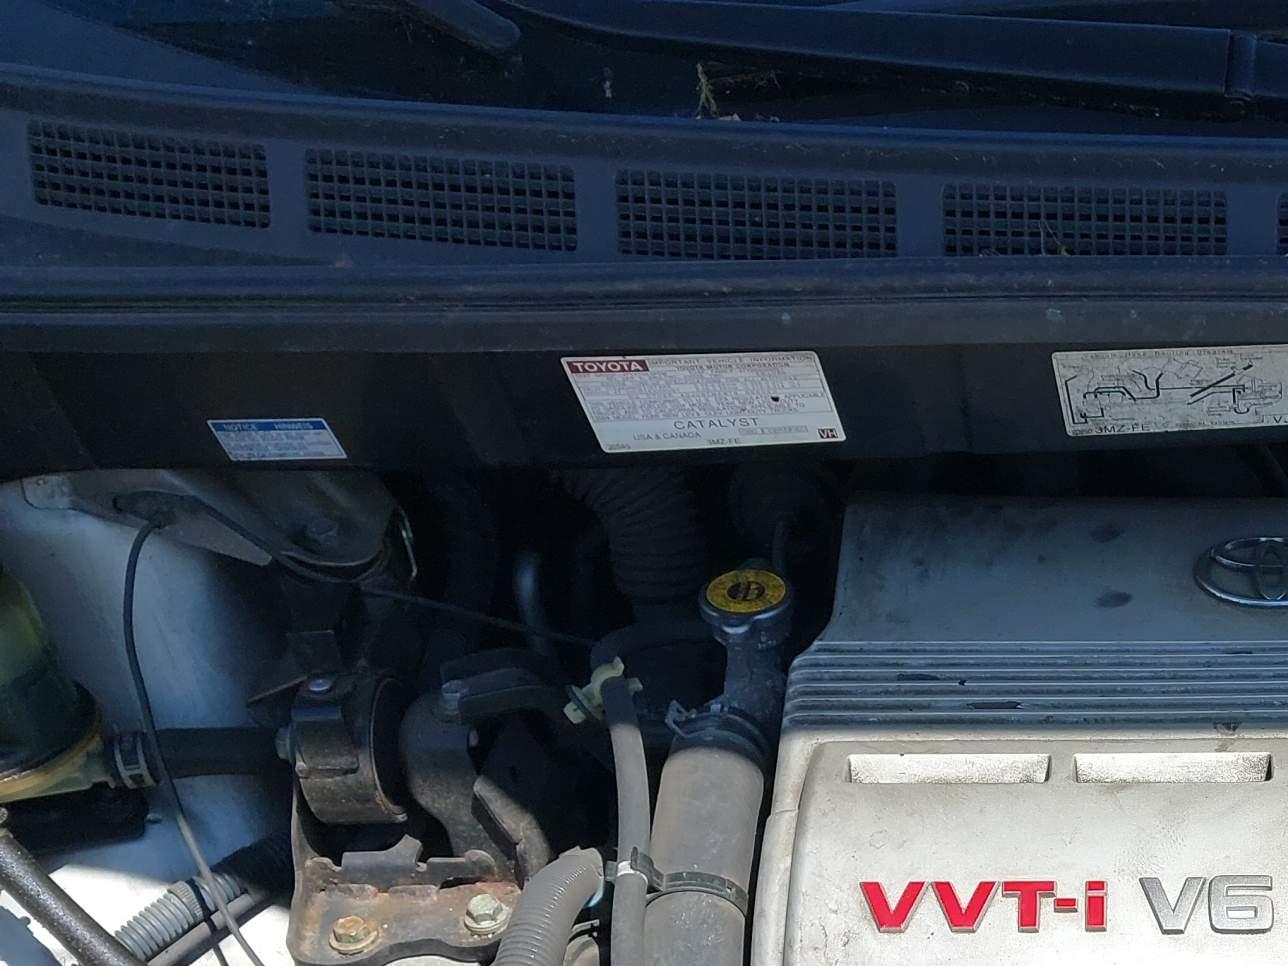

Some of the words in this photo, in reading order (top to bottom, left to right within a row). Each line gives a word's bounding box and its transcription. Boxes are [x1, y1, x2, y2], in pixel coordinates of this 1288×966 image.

[571, 361, 643, 373] TOYOTA
[673, 417, 759, 431] CATALYST
[663, 430, 702, 440] CANADA
[819, 429, 838, 439] VH
[859, 880, 1109, 934] VVT-i
[1138, 874, 1275, 935] V6
